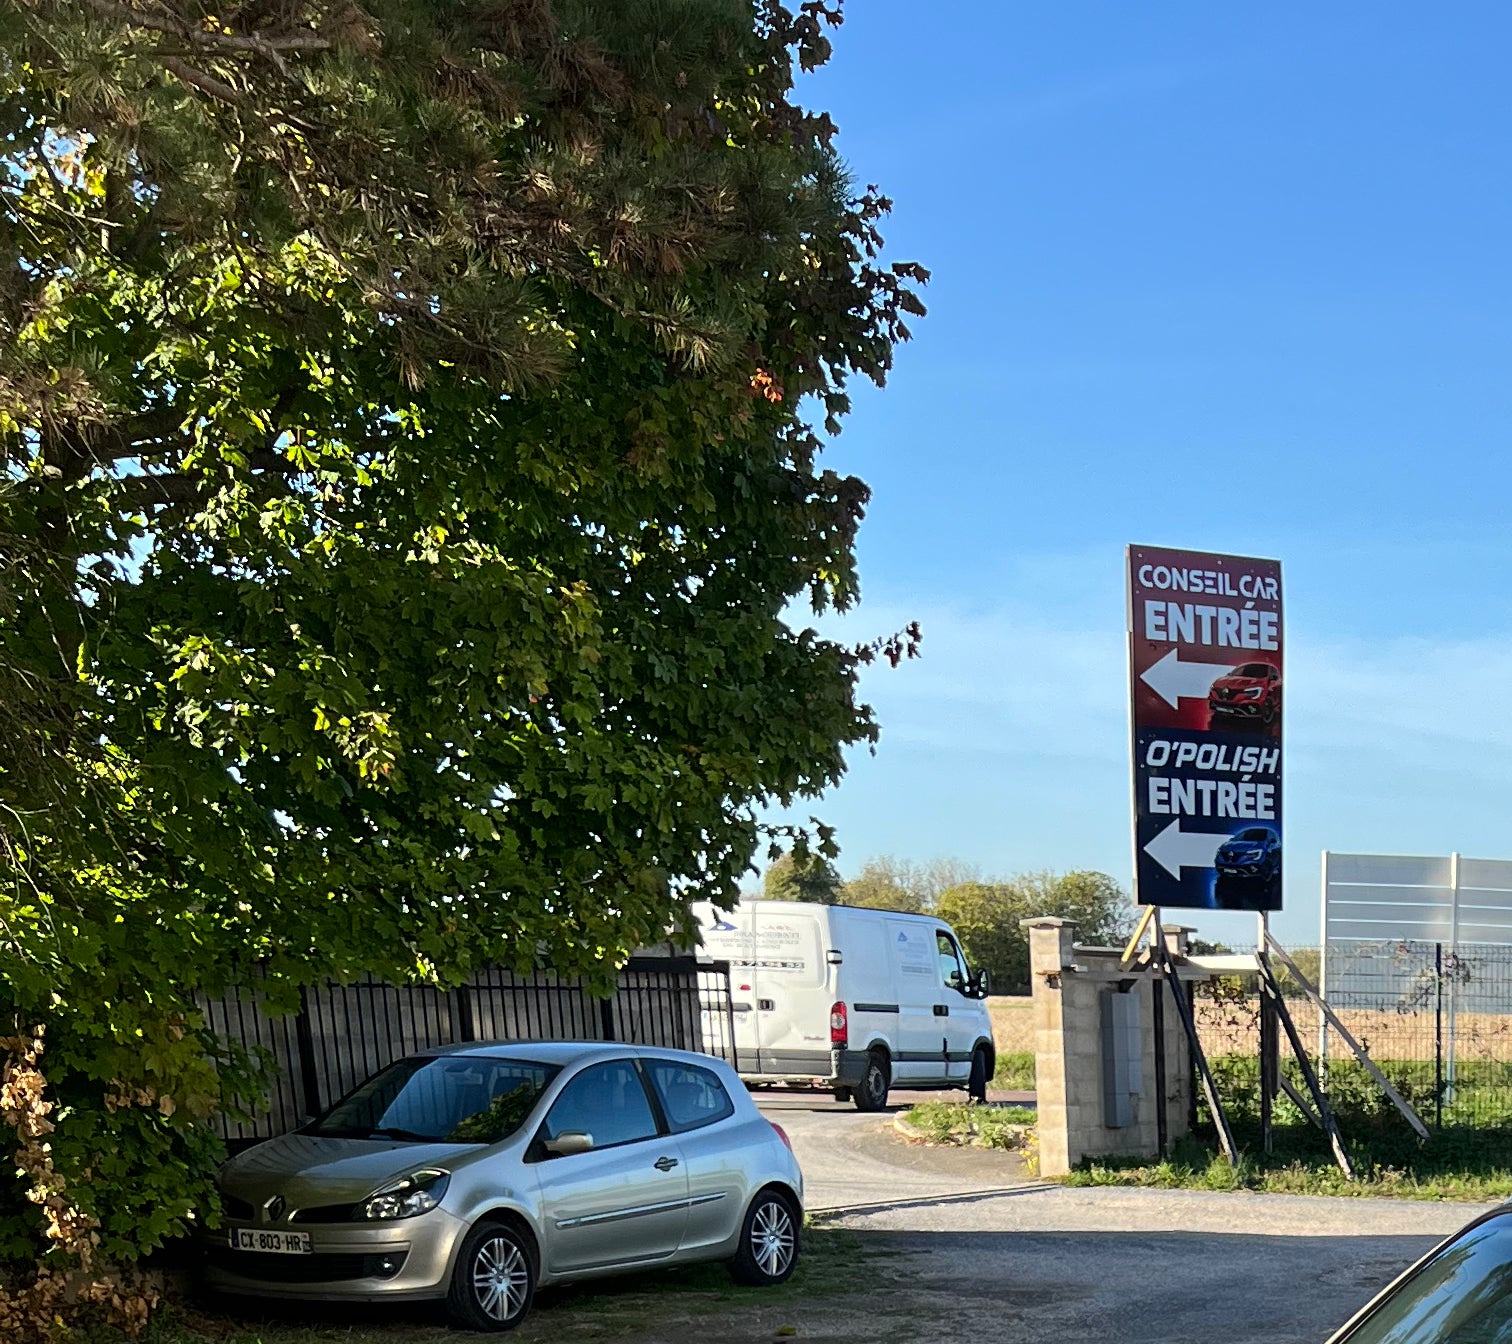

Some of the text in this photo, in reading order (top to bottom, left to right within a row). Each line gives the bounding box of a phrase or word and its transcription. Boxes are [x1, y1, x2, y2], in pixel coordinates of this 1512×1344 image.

[1138, 564, 1279, 600] CONSEIL CAR
[1145, 600, 1278, 651] ENTRÉE
[1146, 739, 1280, 774] O'POLISH
[1148, 774, 1275, 821] ENTRÉE
